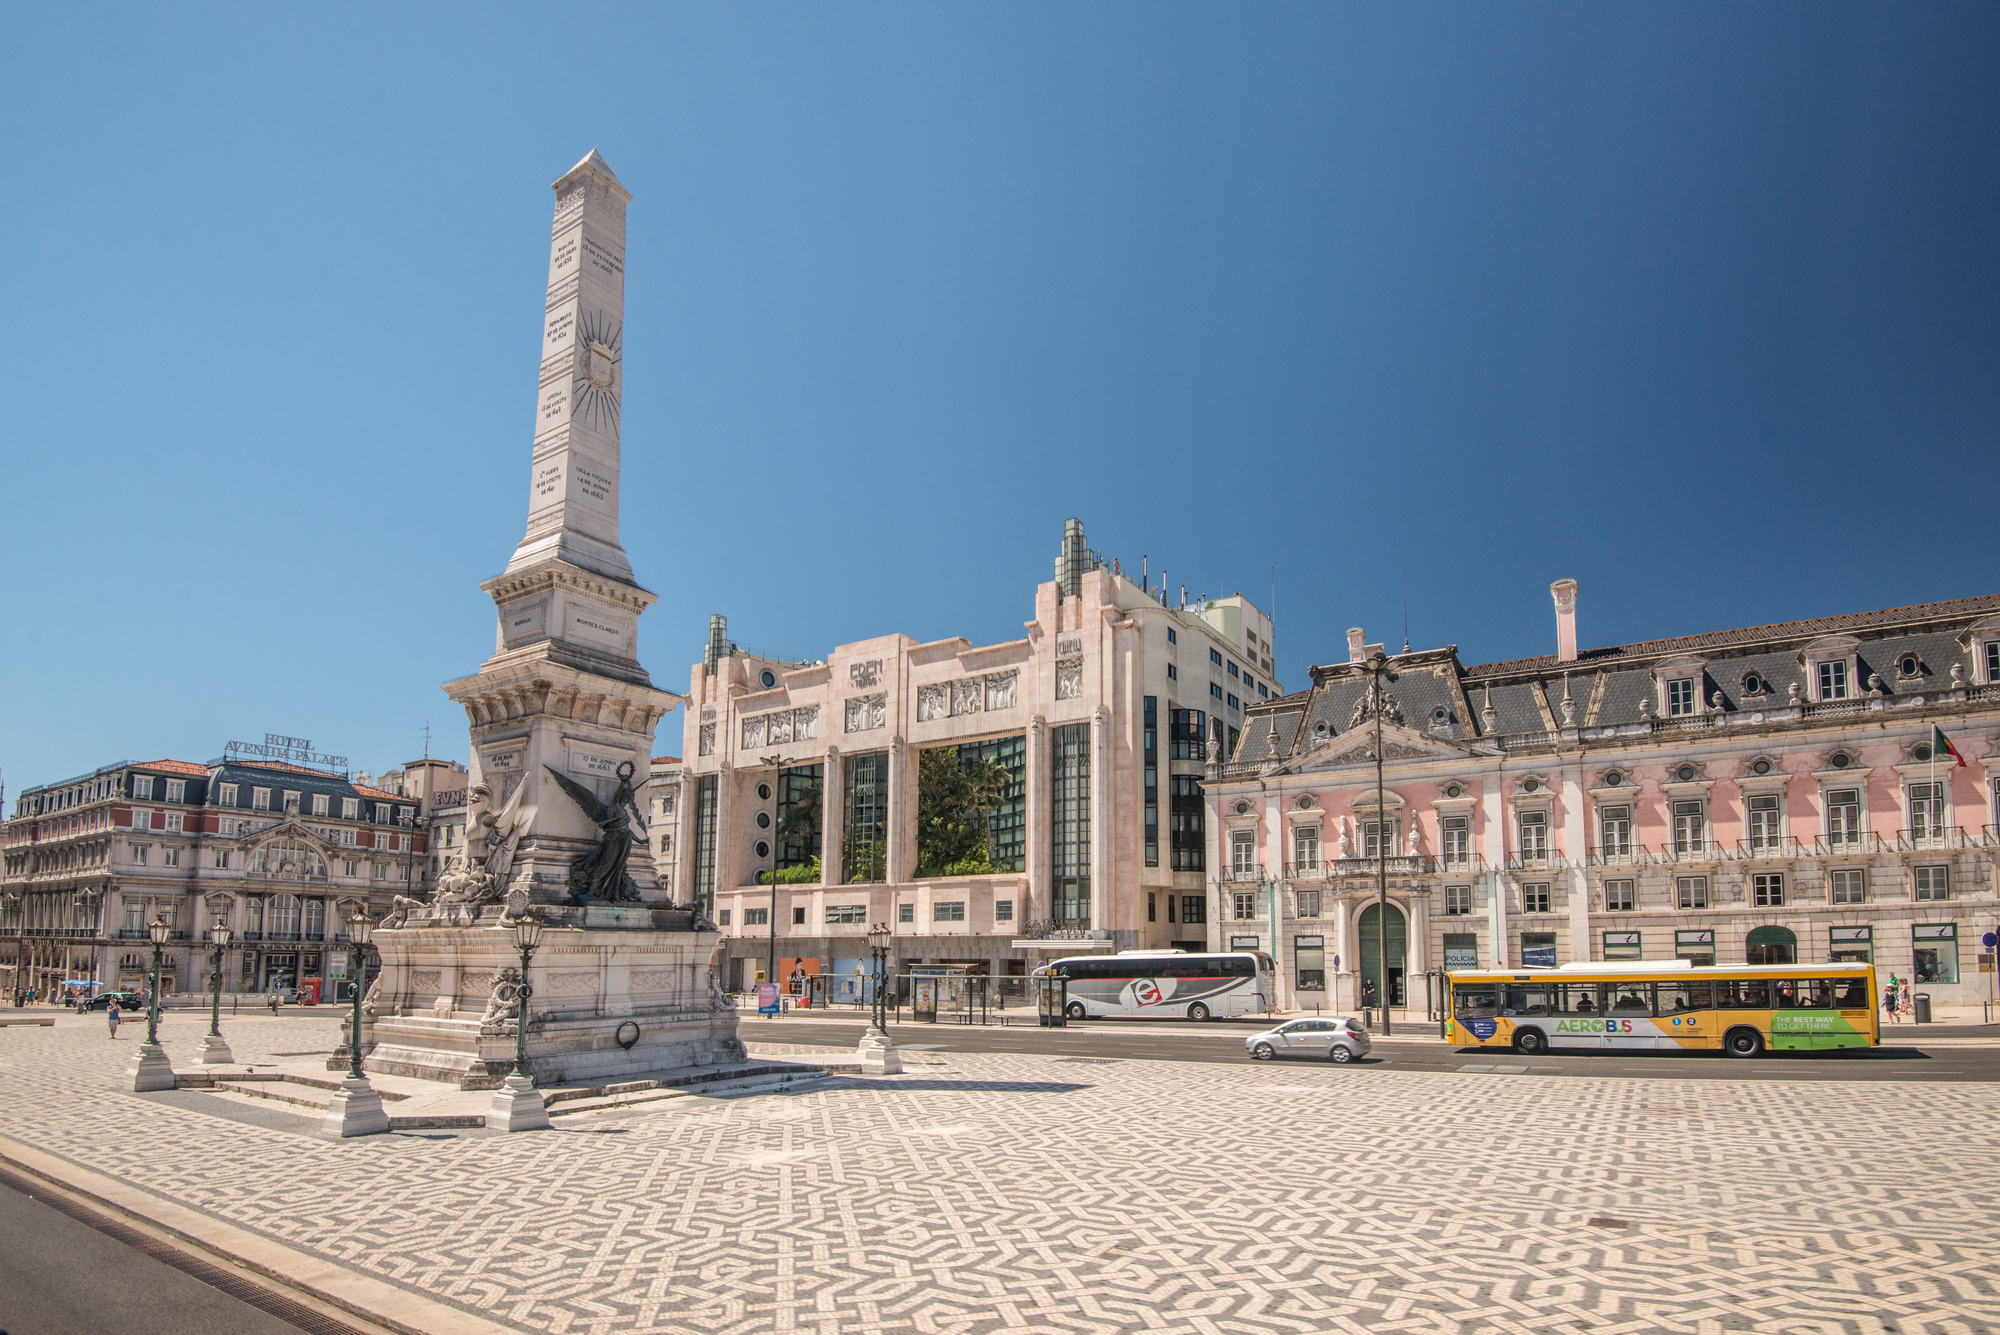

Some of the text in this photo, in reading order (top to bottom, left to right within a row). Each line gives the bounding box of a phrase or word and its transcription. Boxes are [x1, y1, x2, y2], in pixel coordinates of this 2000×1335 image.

[576, 466, 591, 476] VILLA
[576, 618, 619, 634] MONTES CLAROS
[850, 658, 883, 680] EDEN
[264, 733, 315, 750] HOTEL
[224, 740, 348, 767] AVENIDA PALACE
[597, 764, 611, 772] 1665
[599, 758, 616, 766] JUNHO
[1556, 1020, 1632, 1032] AEROBUS
